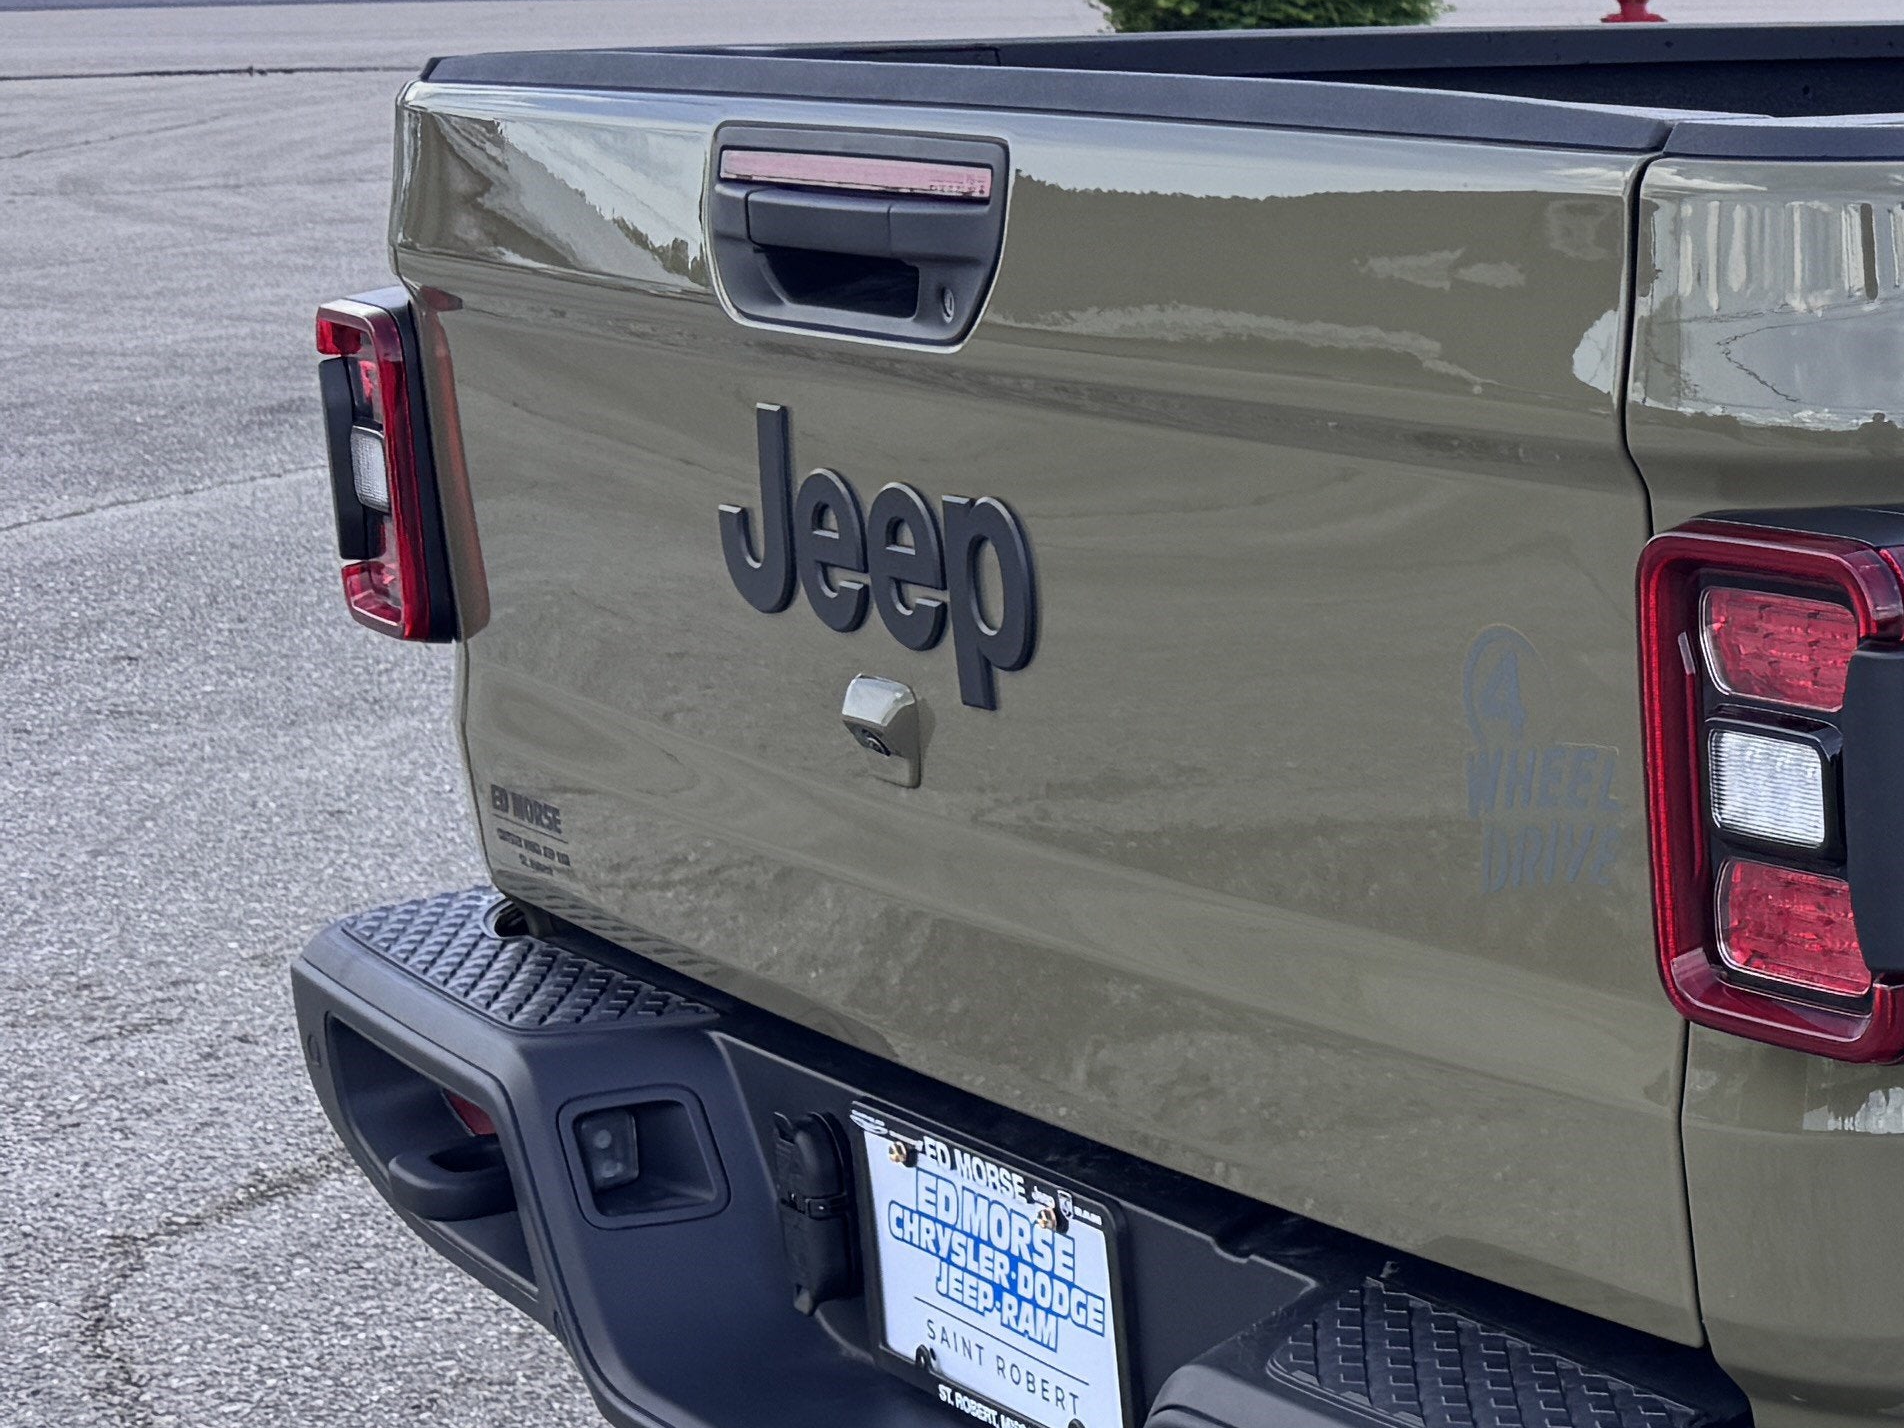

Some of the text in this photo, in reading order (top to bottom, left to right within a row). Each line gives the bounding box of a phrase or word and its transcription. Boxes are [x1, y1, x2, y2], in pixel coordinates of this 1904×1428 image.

[718, 402, 1038, 711] Jeep
[1465, 745, 1624, 819] WHEEL
[1480, 822, 1622, 894] DRIVE
[923, 1135, 951, 1172] ED
[954, 1149, 1028, 1204] MORSE
[916, 1167, 1075, 1284] ED MORSE
[926, 1319, 1080, 1415] SAINT ROBERT
[938, 1383, 954, 1406] ST.
